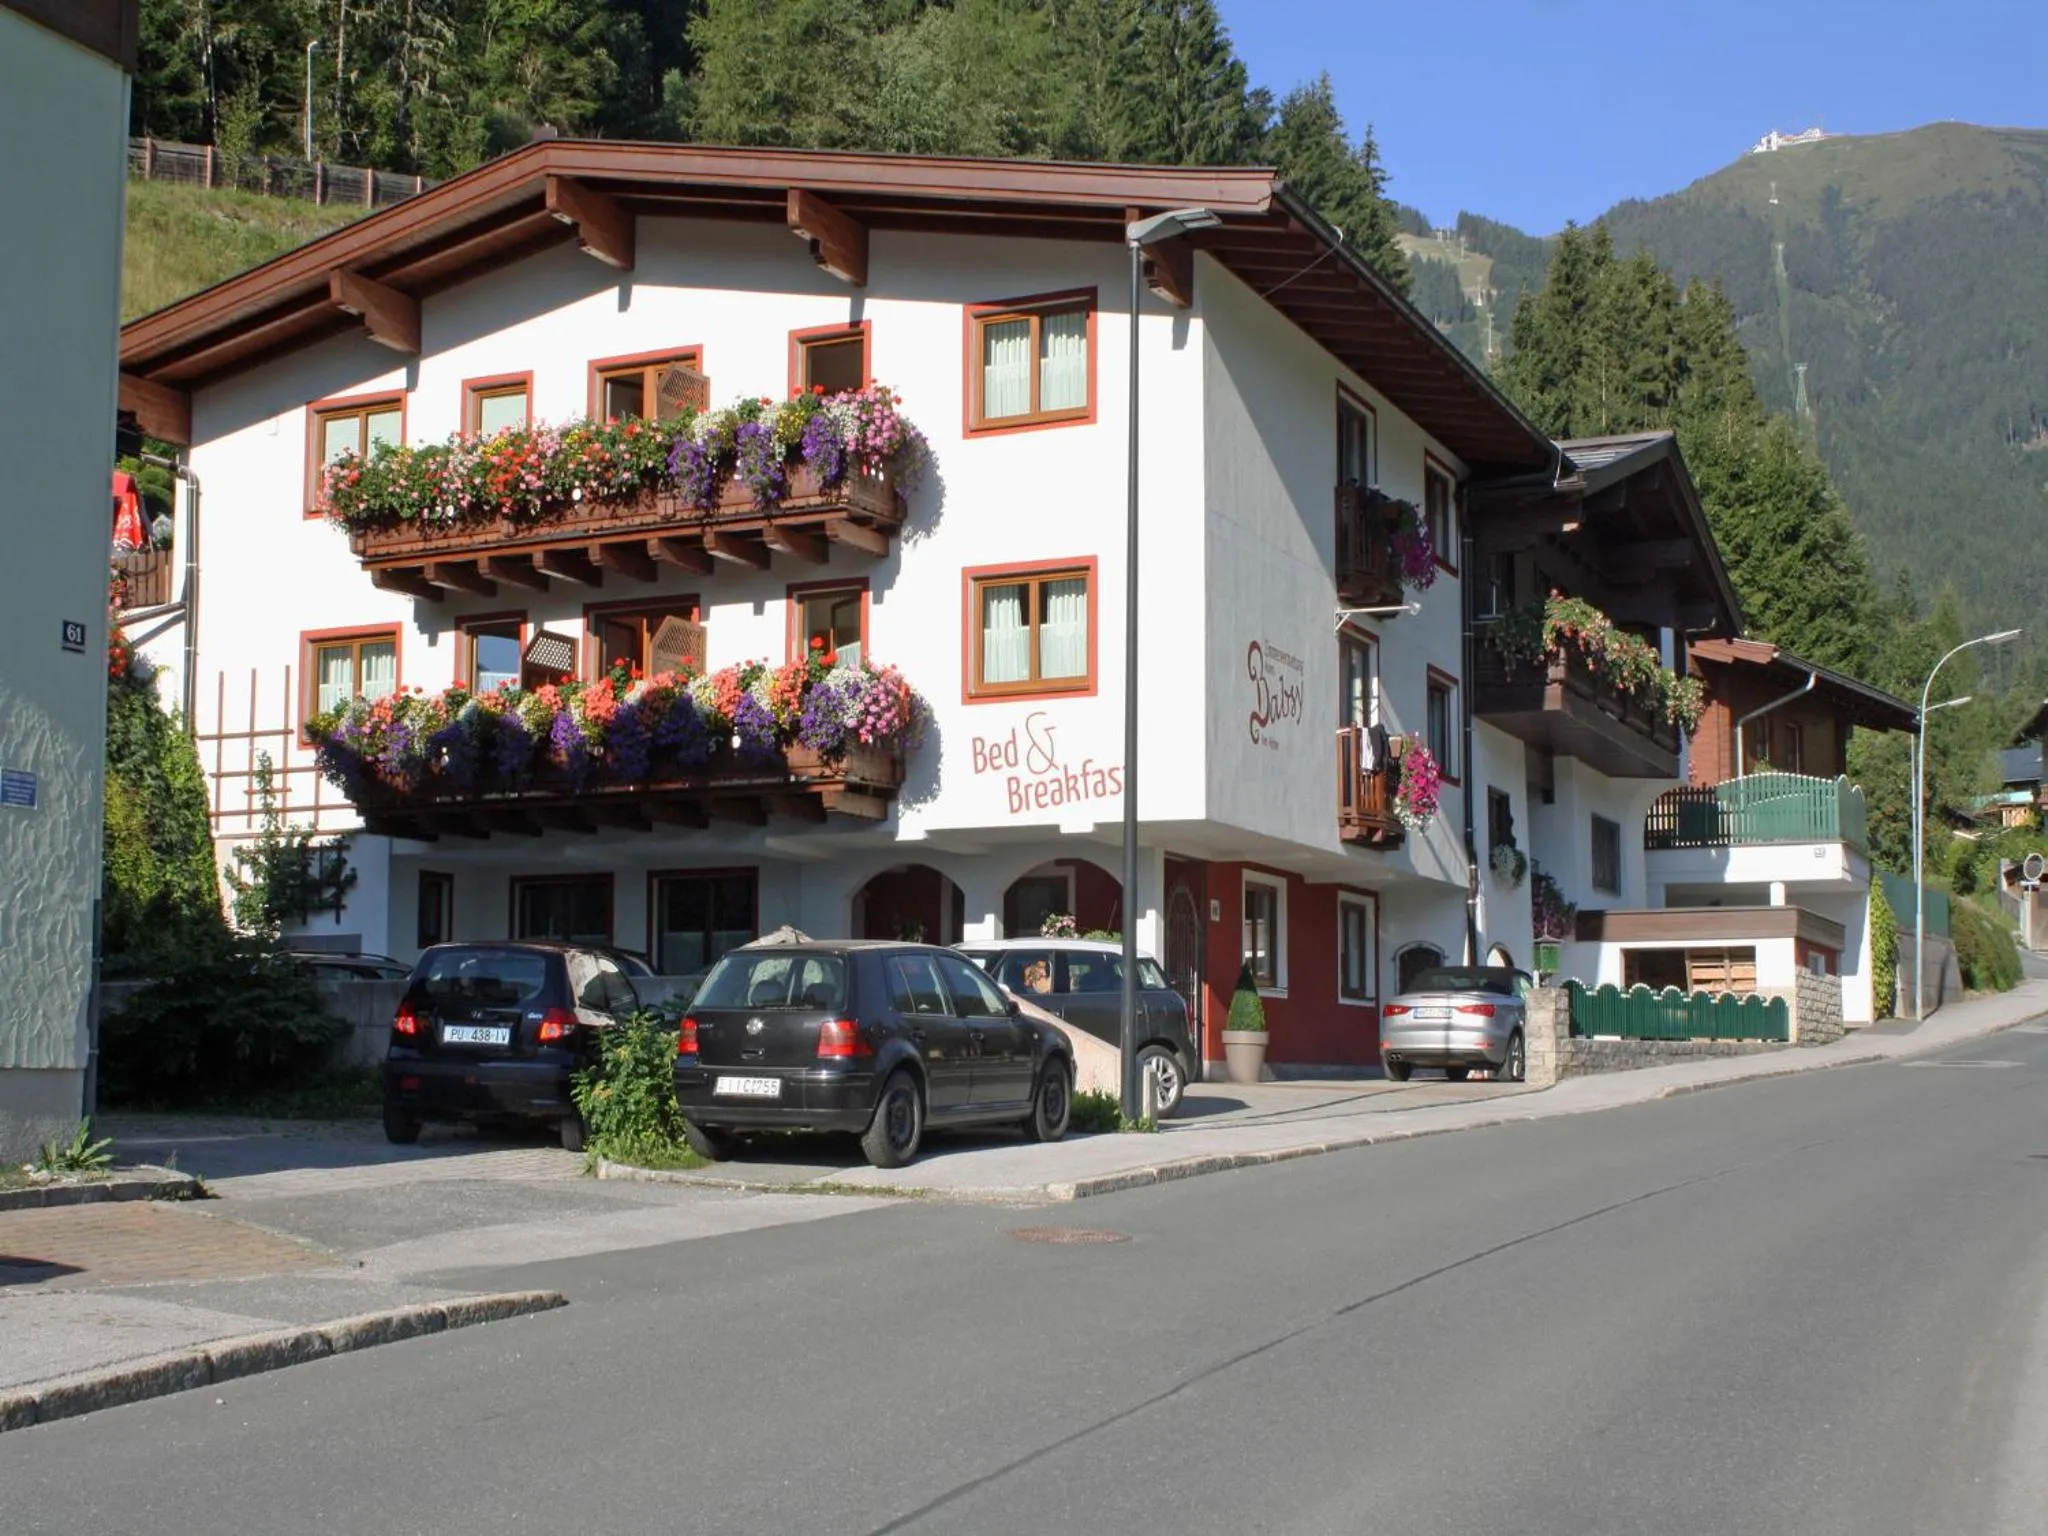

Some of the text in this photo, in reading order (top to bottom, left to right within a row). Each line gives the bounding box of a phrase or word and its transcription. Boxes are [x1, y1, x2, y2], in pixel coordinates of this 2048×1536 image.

[66, 623, 82, 642] 61
[972, 711, 1059, 775] Bed &
[1007, 759, 1126, 813] Breakfas
